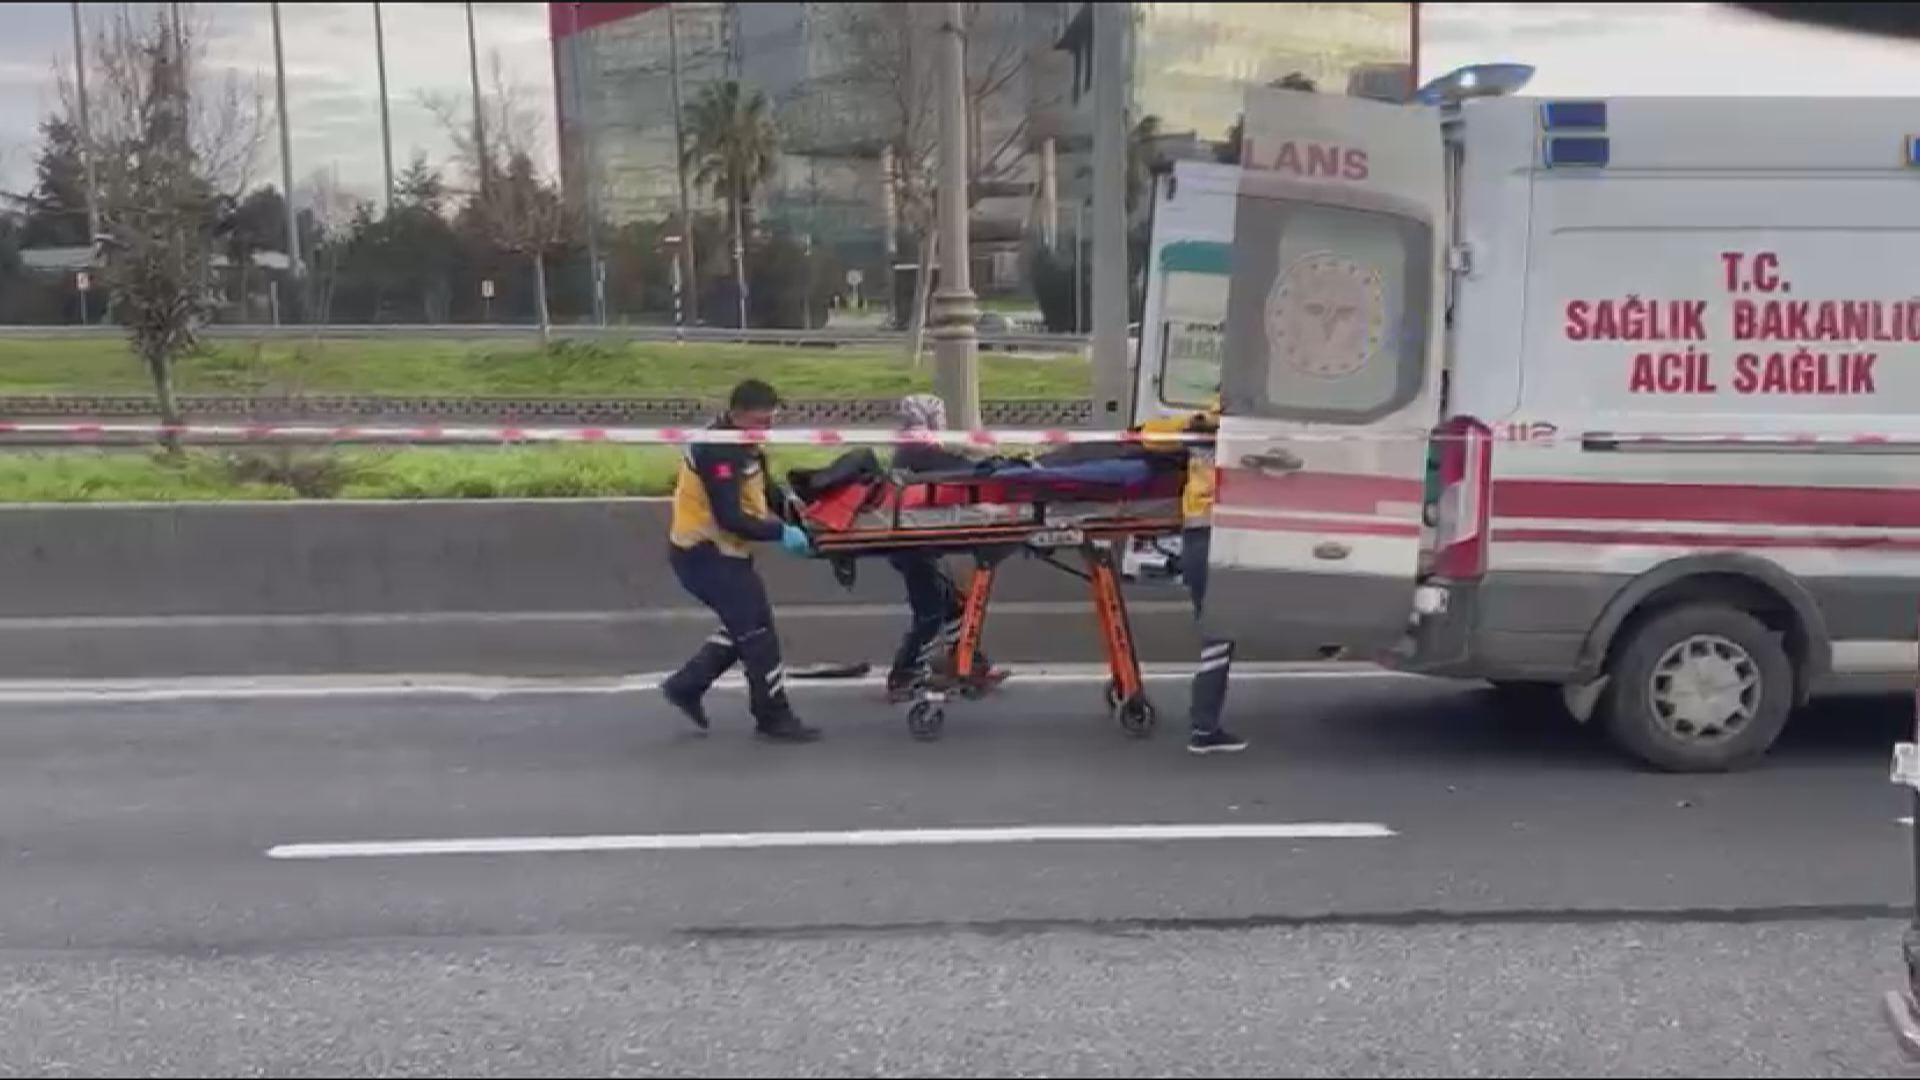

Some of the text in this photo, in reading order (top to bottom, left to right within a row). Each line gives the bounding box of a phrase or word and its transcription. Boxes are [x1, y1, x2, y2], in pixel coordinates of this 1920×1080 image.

[1242, 138, 1369, 180] LANS
[1720, 252, 1791, 292] T.C.
[1566, 293, 1707, 341] SAĞLIK
[1630, 344, 1877, 393] ACİL SAĞLIK
